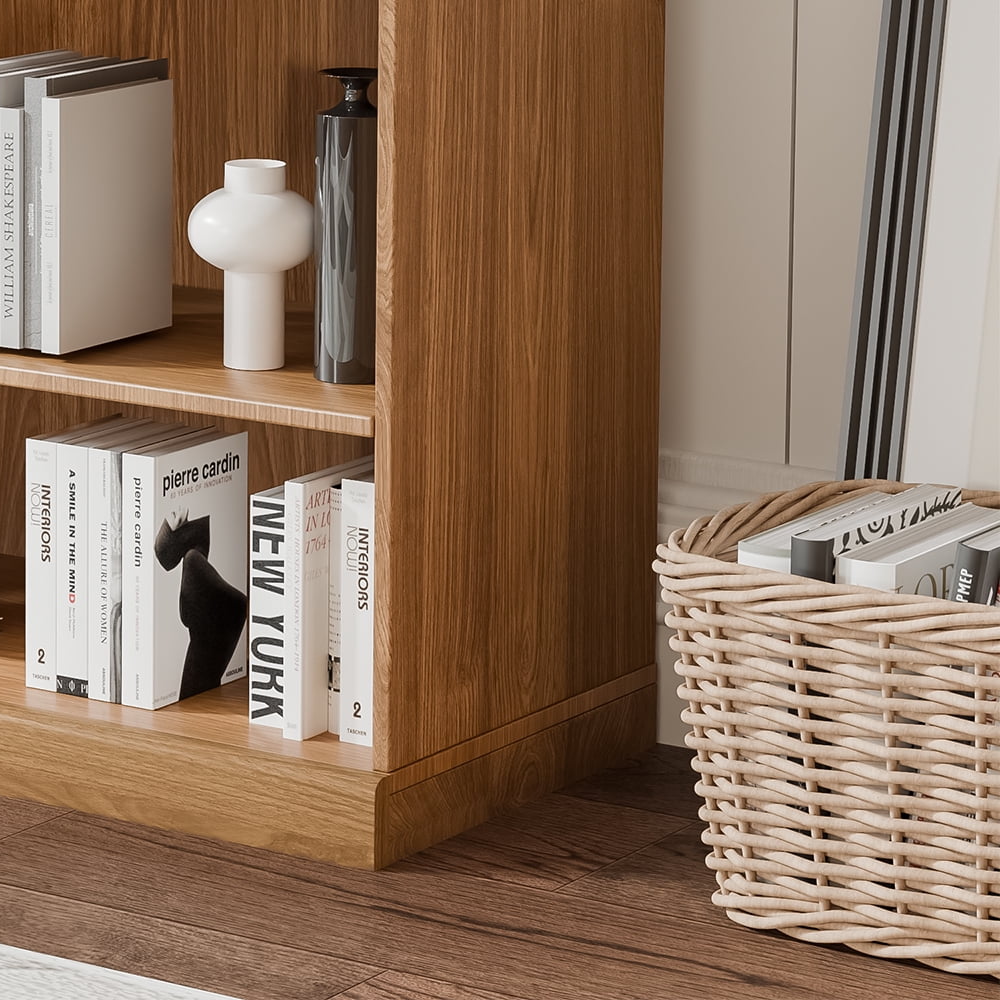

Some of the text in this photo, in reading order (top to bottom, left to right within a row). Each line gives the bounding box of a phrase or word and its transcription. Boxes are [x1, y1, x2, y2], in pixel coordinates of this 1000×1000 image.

[3, 132, 14, 319] WILLIAM SHAKESPEARE
[68, 469, 76, 478] A
[163, 452, 240, 497] pierre cardin
[204, 475, 233, 488] INNOVATION
[31, 482, 40, 526] NOW!
[68, 480, 76, 520] SMILE
[41, 484, 51, 563] INTERIORS
[68, 521, 76, 538] IN
[133, 476, 142, 568] pierre cardin
[305, 513, 319, 532] IN
[68, 540, 76, 565] THE
[346, 525, 358, 572] NOW!
[68, 567, 76, 604] MIND
[357, 527, 370, 611] INTERIORS
[100, 586, 107, 602] OF
[250, 500, 285, 720] NEW YORK
[100, 603, 108, 644] WOMEN
[37, 649, 45, 664] 2
[353, 702, 362, 719] 2
[346, 727, 367, 737] TASCHEN
